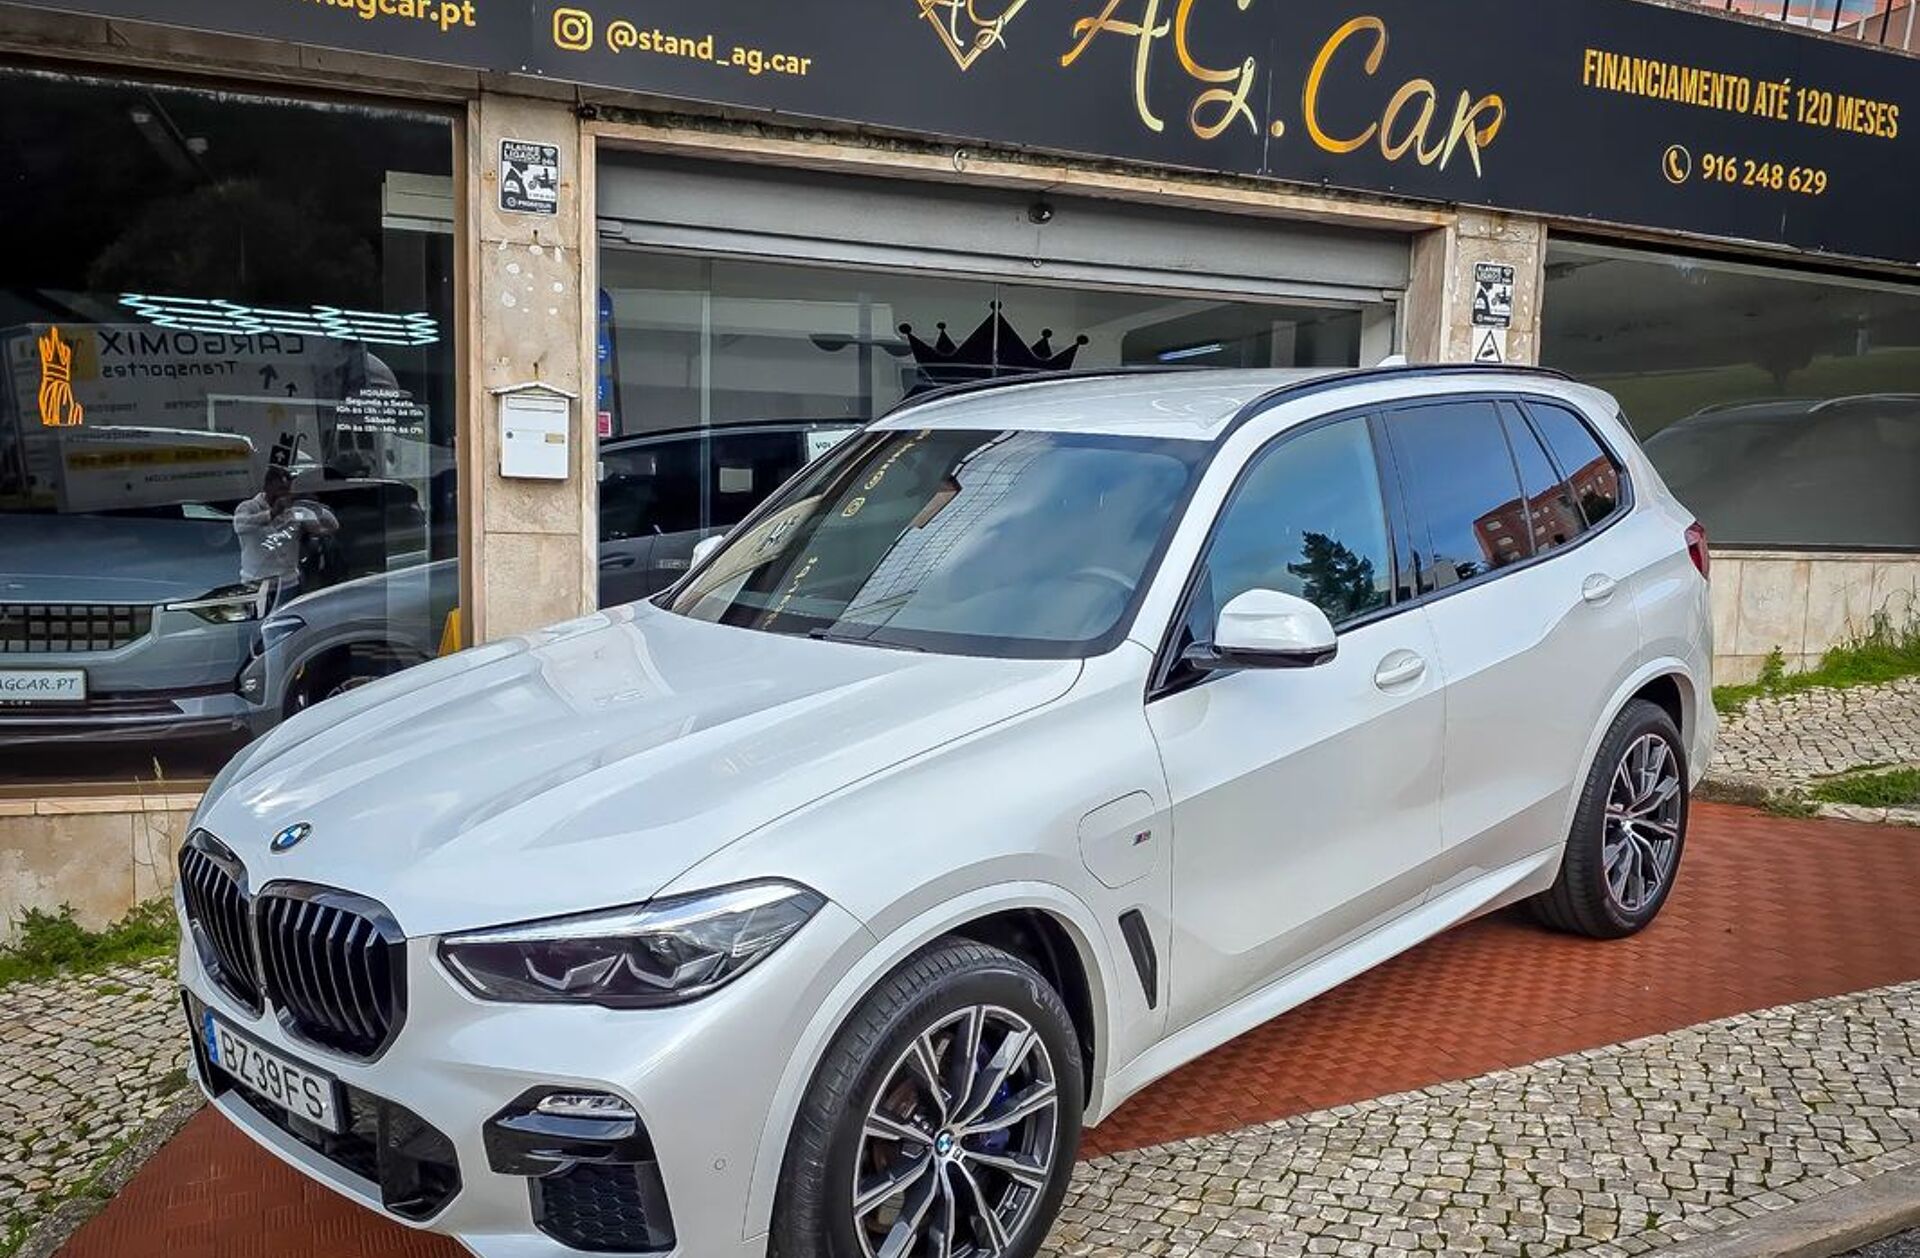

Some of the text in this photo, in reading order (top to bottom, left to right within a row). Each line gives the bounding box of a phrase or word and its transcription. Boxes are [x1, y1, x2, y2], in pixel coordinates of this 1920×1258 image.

[606, 20, 812, 76] @stand_ag.car
[1583, 48, 1900, 139] FINANCIAMENTO ATÉ 120 MESES
[1702, 153, 1828, 196] 916 248 629
